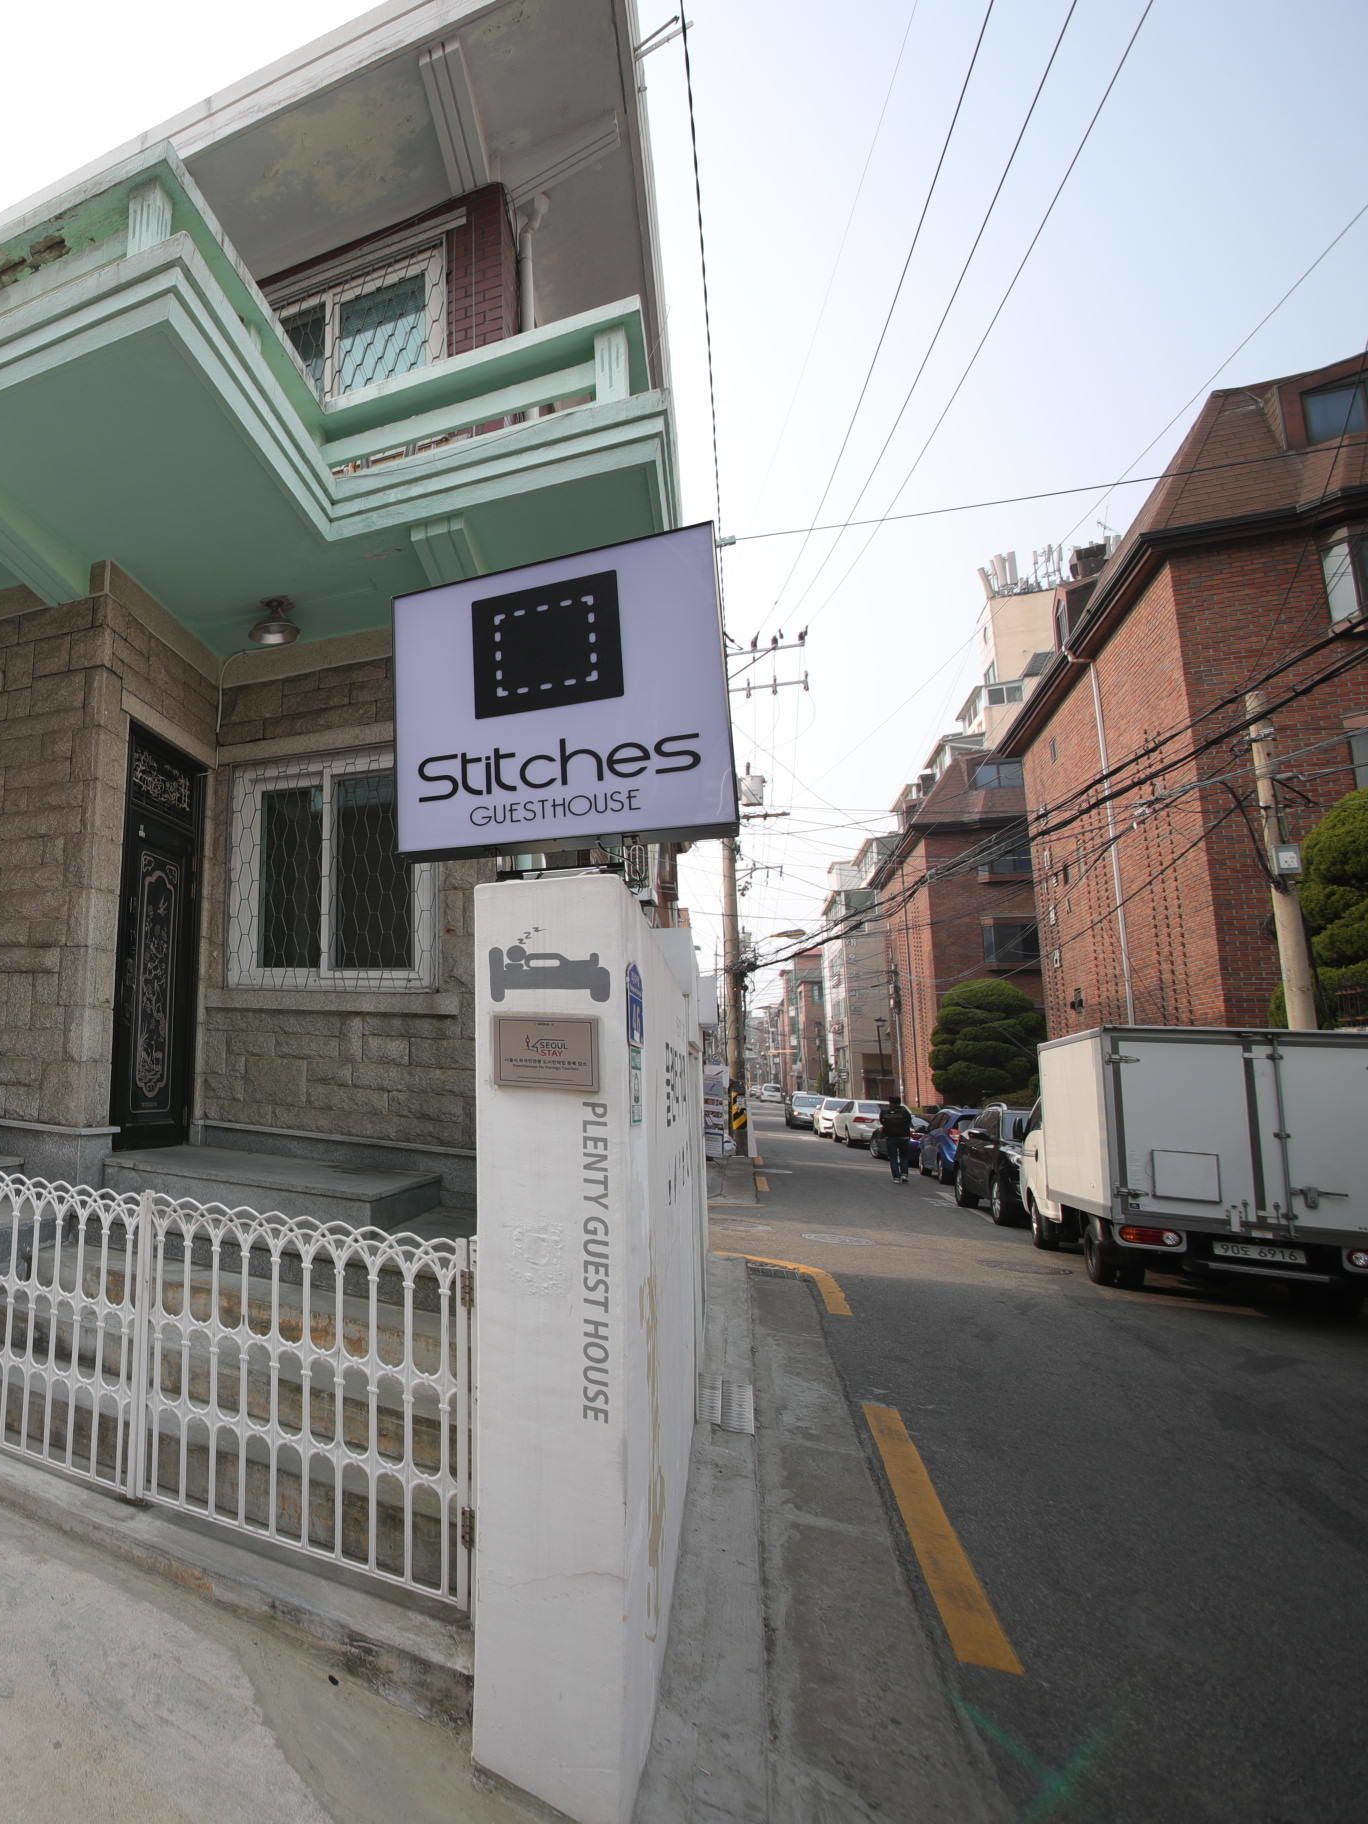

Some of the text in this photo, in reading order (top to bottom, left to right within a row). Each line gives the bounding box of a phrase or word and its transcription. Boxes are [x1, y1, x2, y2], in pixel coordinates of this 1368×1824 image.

[418, 732, 702, 803] Stitches
[469, 788, 642, 827] GUESTHOUSE
[539, 1041, 568, 1050] SEOUL
[540, 1049, 564, 1057] STAY
[582, 1100, 610, 1425] PLENTY GUEST HOUSE
[1257, 1247, 1299, 1261] 6916
